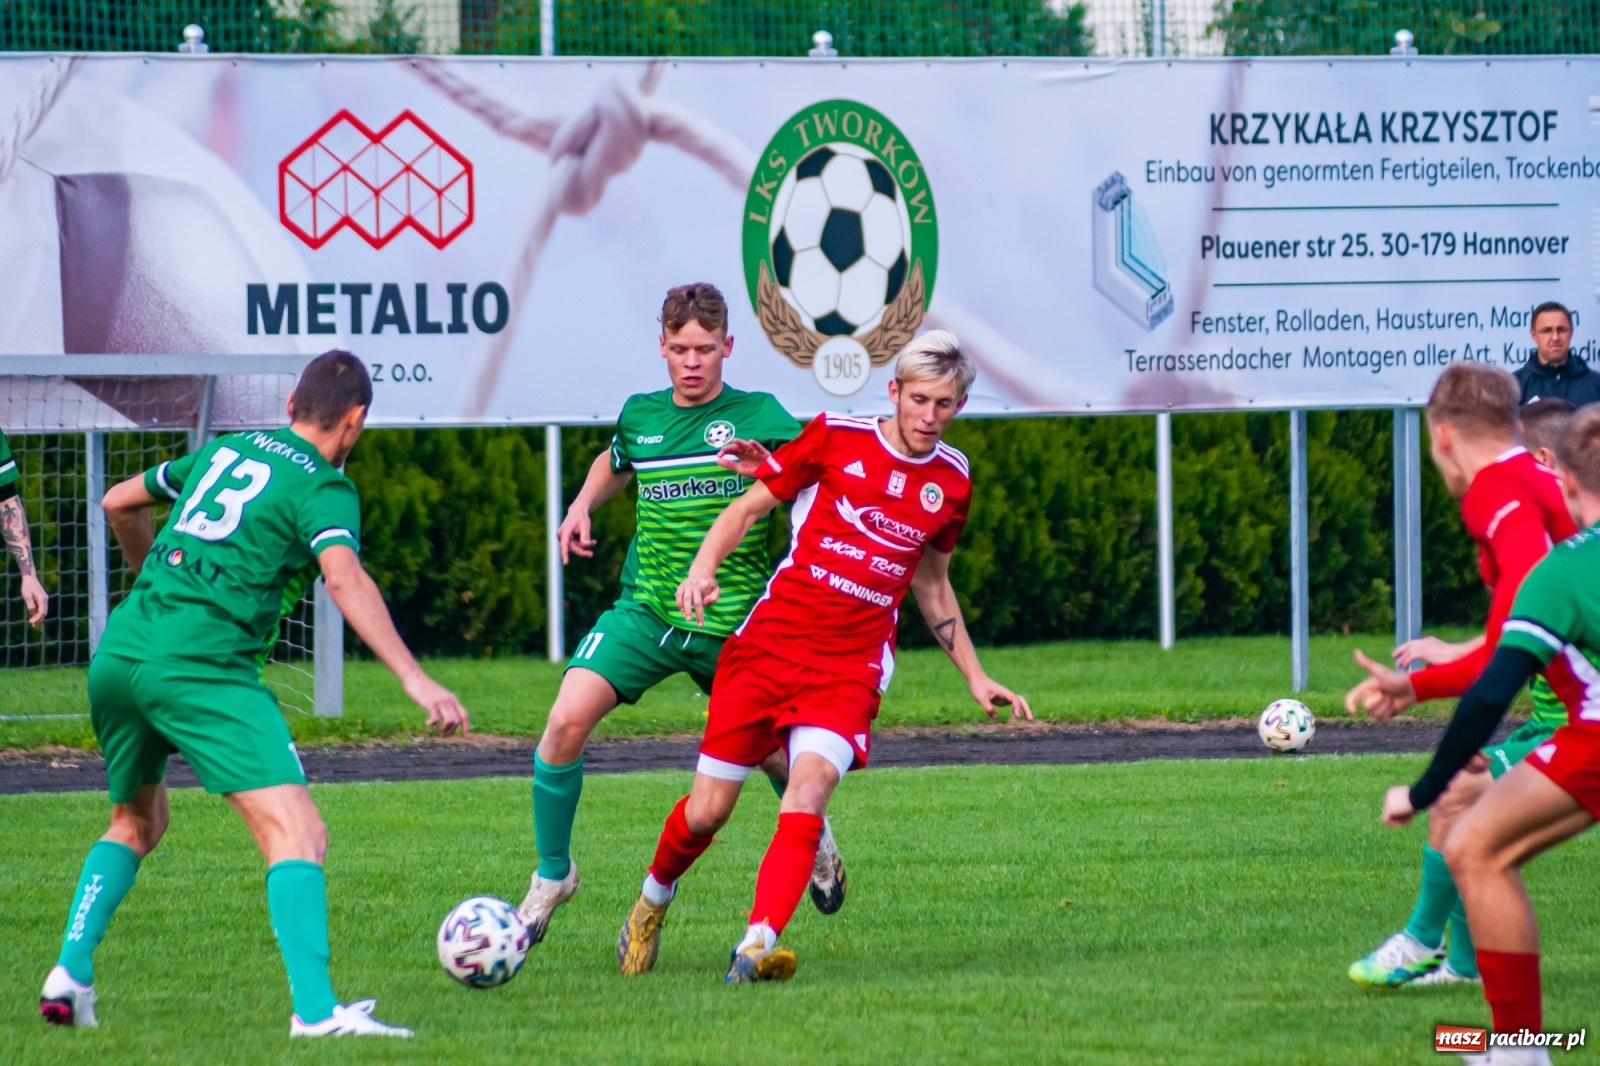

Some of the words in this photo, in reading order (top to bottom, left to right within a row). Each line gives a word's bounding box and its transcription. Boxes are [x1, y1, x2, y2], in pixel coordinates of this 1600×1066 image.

[1210, 111, 1373, 146] KRZYKAŁA
[1381, 110, 1559, 144] KRZYSZTOF
[749, 150, 787, 225] LKS
[793, 109, 933, 225] TWORKÓW
[1146, 160, 1215, 183] Einbau
[1221, 165, 1257, 182] von
[1264, 161, 1374, 189] genormten
[1381, 157, 1501, 187] Fertigteilen,
[1201, 234, 1301, 260] Plauener
[1306, 235, 1335, 257] str
[1341, 233, 1374, 258] 25.
[1381, 231, 1457, 257] 30-179
[1464, 231, 1569, 255] Hannover
[246, 281, 510, 335] METALIO
[1190, 310, 1270, 336] Fenster,
[1276, 308, 1370, 334] Rolladen,
[1376, 307, 1484, 331] Hausturen,
[823, 353, 862, 379] 1905
[1124, 347, 1292, 372] Terrassendacher
[1302, 346, 1407, 374] Montagen
[1413, 343, 1457, 367] aller
[172, 445, 272, 543] 13
[638, 472, 745, 500] osiarka.pl
[829, 573, 893, 607] WENINGER
